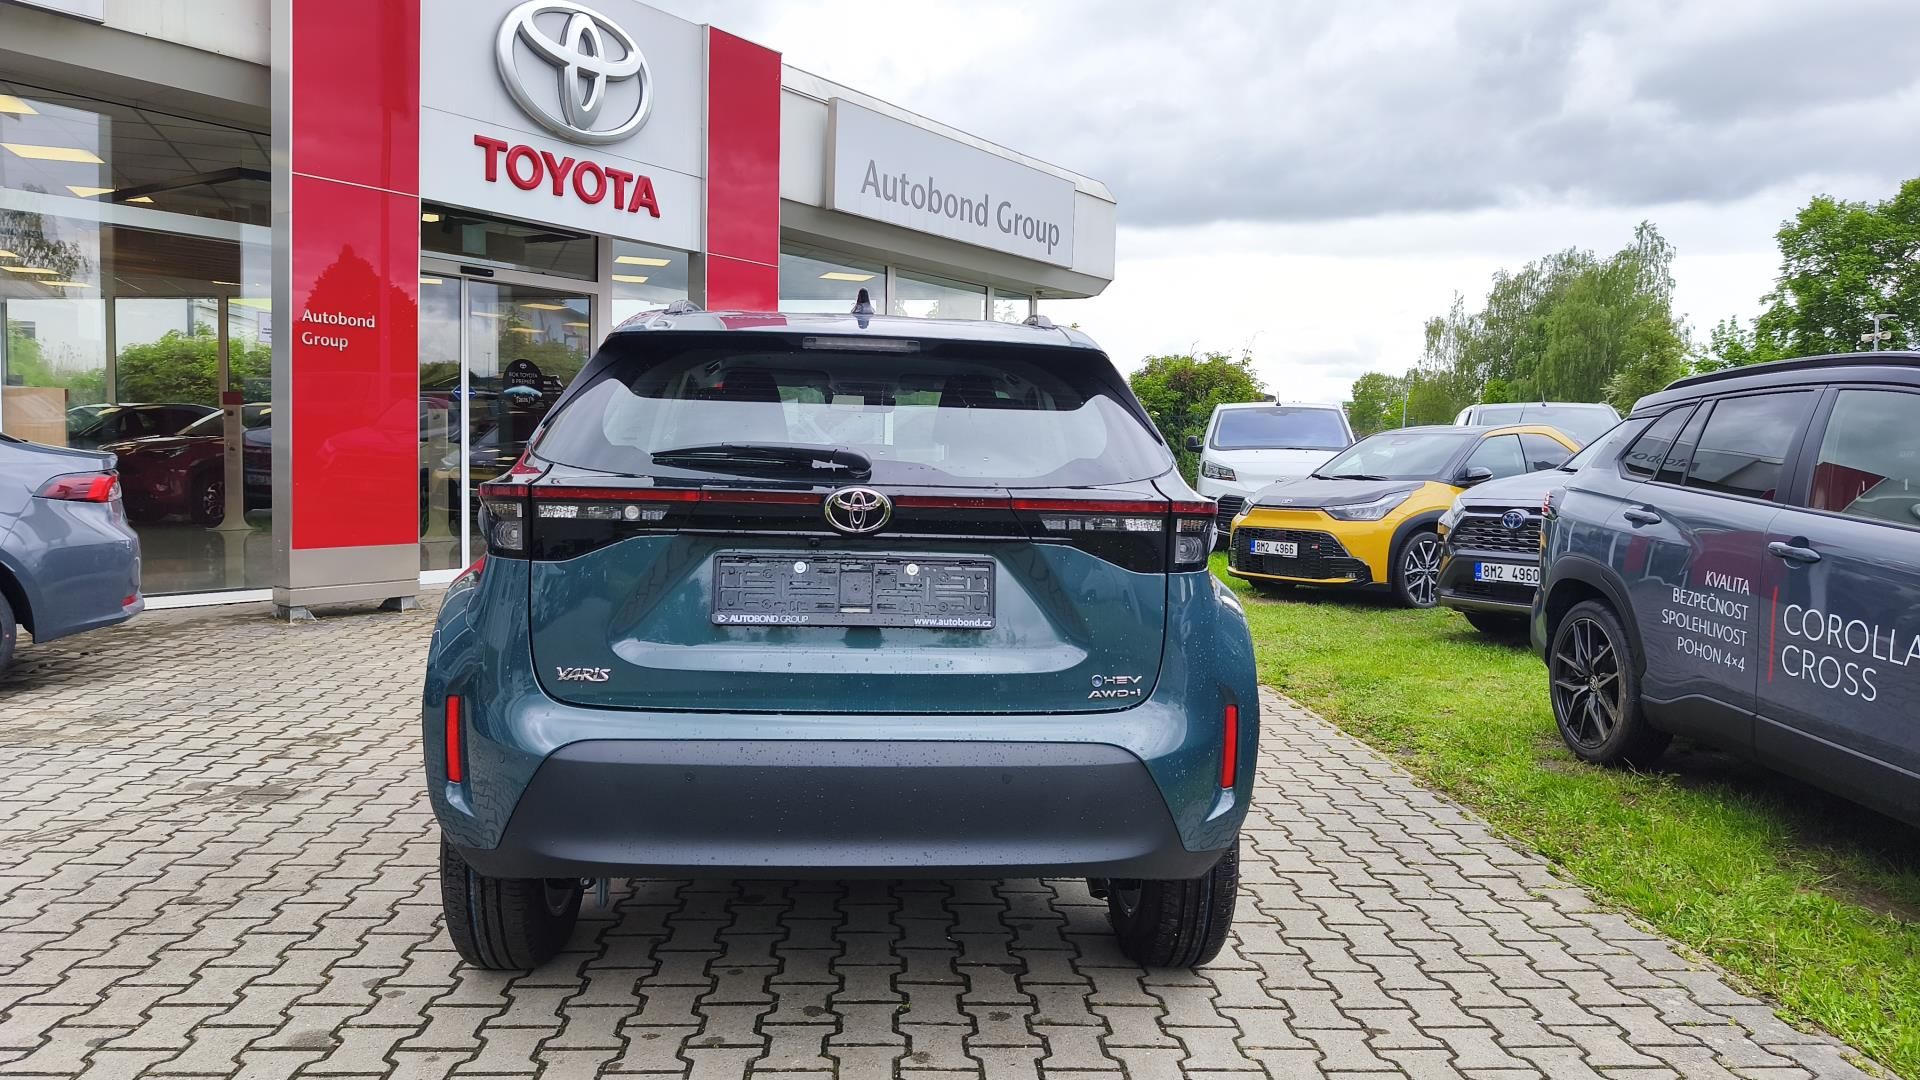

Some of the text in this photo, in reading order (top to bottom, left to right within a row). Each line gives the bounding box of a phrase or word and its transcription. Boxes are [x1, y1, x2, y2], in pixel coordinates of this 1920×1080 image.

[474, 134, 660, 218] TOYOTA
[860, 159, 1060, 255] Autobond Group
[302, 309, 375, 328] Autobond
[301, 331, 349, 351] Group
[1275, 543, 1294, 554] 4966
[1483, 564, 1540, 582] 8M2 4960
[1704, 570, 1750, 596] KVALITA
[1672, 587, 1749, 621] BEZPEČNOST
[729, 615, 809, 623] AUTOBOND GROUP
[914, 617, 992, 627] www.autobond.cz
[1661, 608, 1748, 647] SPOLEHLIVOST
[1783, 604, 1920, 667] COROLLA
[1677, 636, 1722, 664] POHON
[1104, 675, 1142, 684] HEV
[1781, 644, 1877, 702] CROSS
